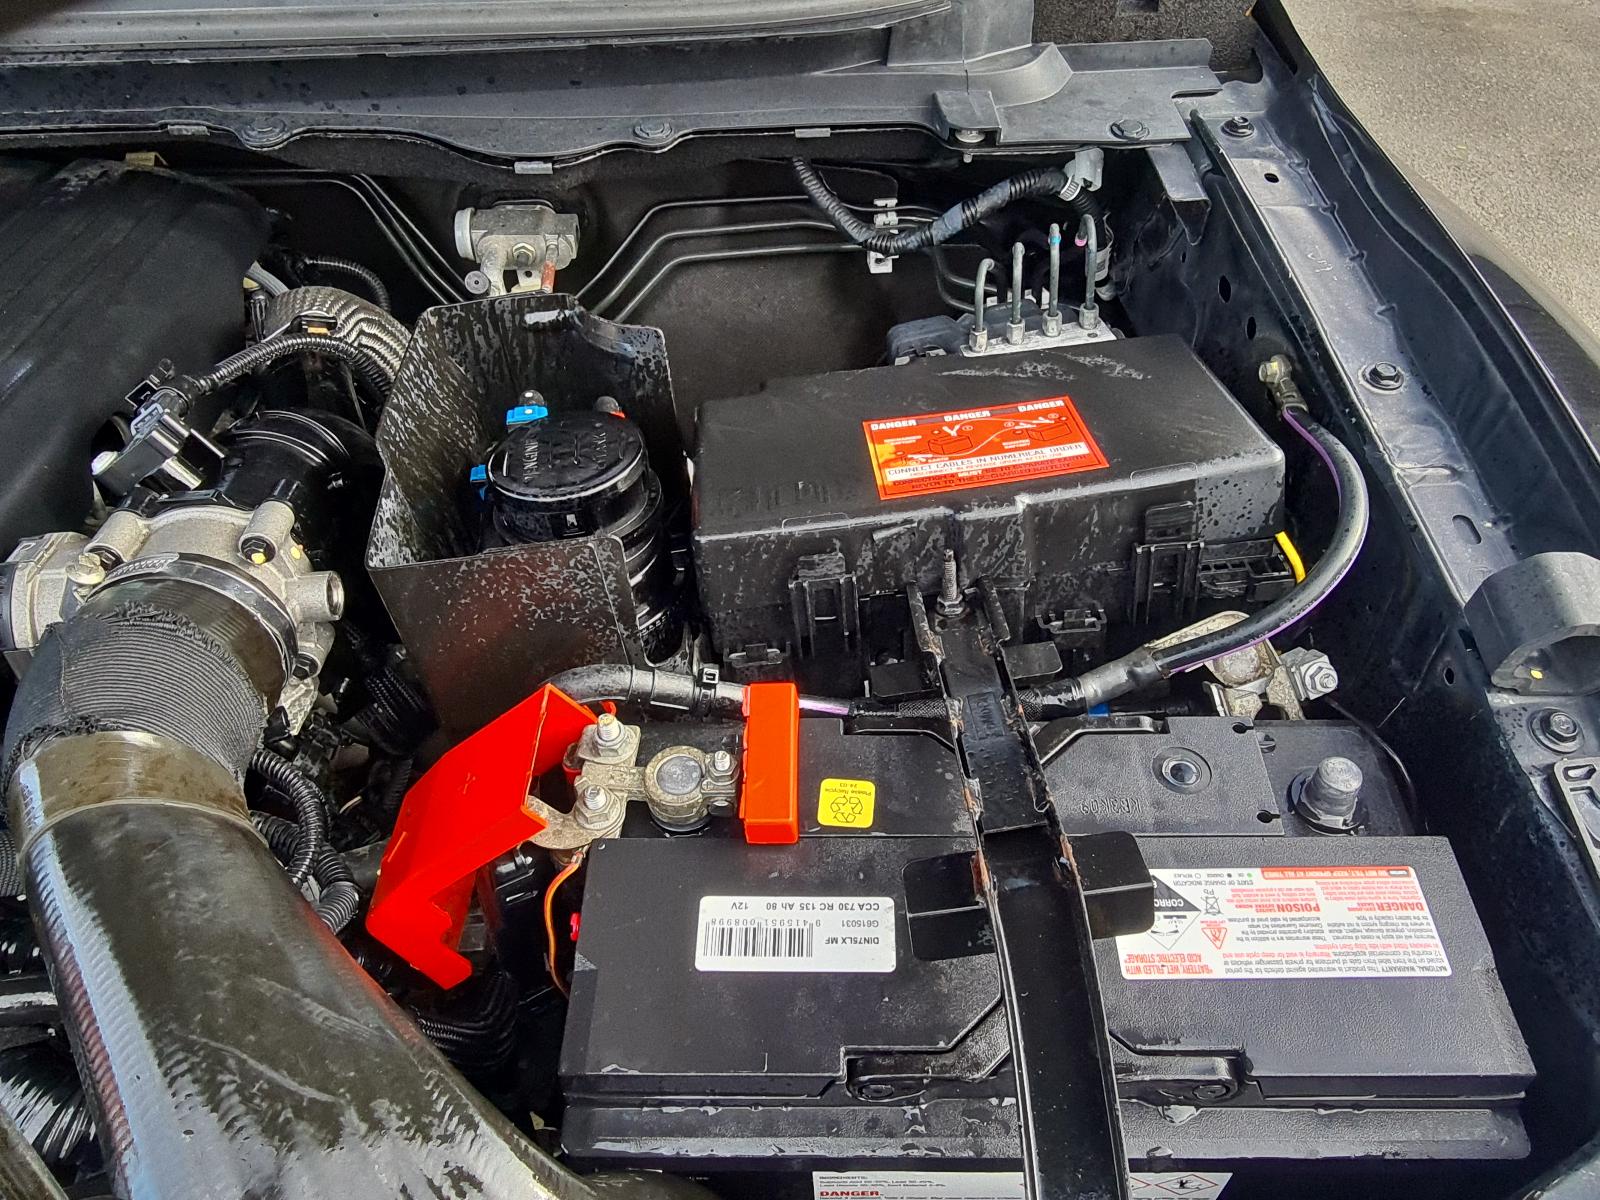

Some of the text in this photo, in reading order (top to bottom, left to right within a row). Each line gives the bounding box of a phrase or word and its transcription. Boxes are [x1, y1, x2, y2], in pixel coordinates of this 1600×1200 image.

[871, 400, 1065, 431] DANGER DANGER DANGER
[888, 463, 932, 475] CONNECT
[936, 459, 973, 470] CABLES
[990, 450, 1044, 462] NUMERICAL
[1049, 444, 1083, 454] ORDER
[731, 901, 880, 911] CCA 730 RC 135 Ah 80 12V
[1276, 903, 1321, 913] POISON
[1375, 902, 1425, 912] DANGER
[711, 918, 821, 928] 9 415951 008998
[841, 919, 879, 928] G615031
[824, 937, 880, 945] DIN75LX MF
[1158, 953, 1185, 963] ELECTRIC
[1187, 953, 1202, 963] ACID
[1125, 965, 1142, 975] WITH
[1143, 965, 1164, 975] FILLED
